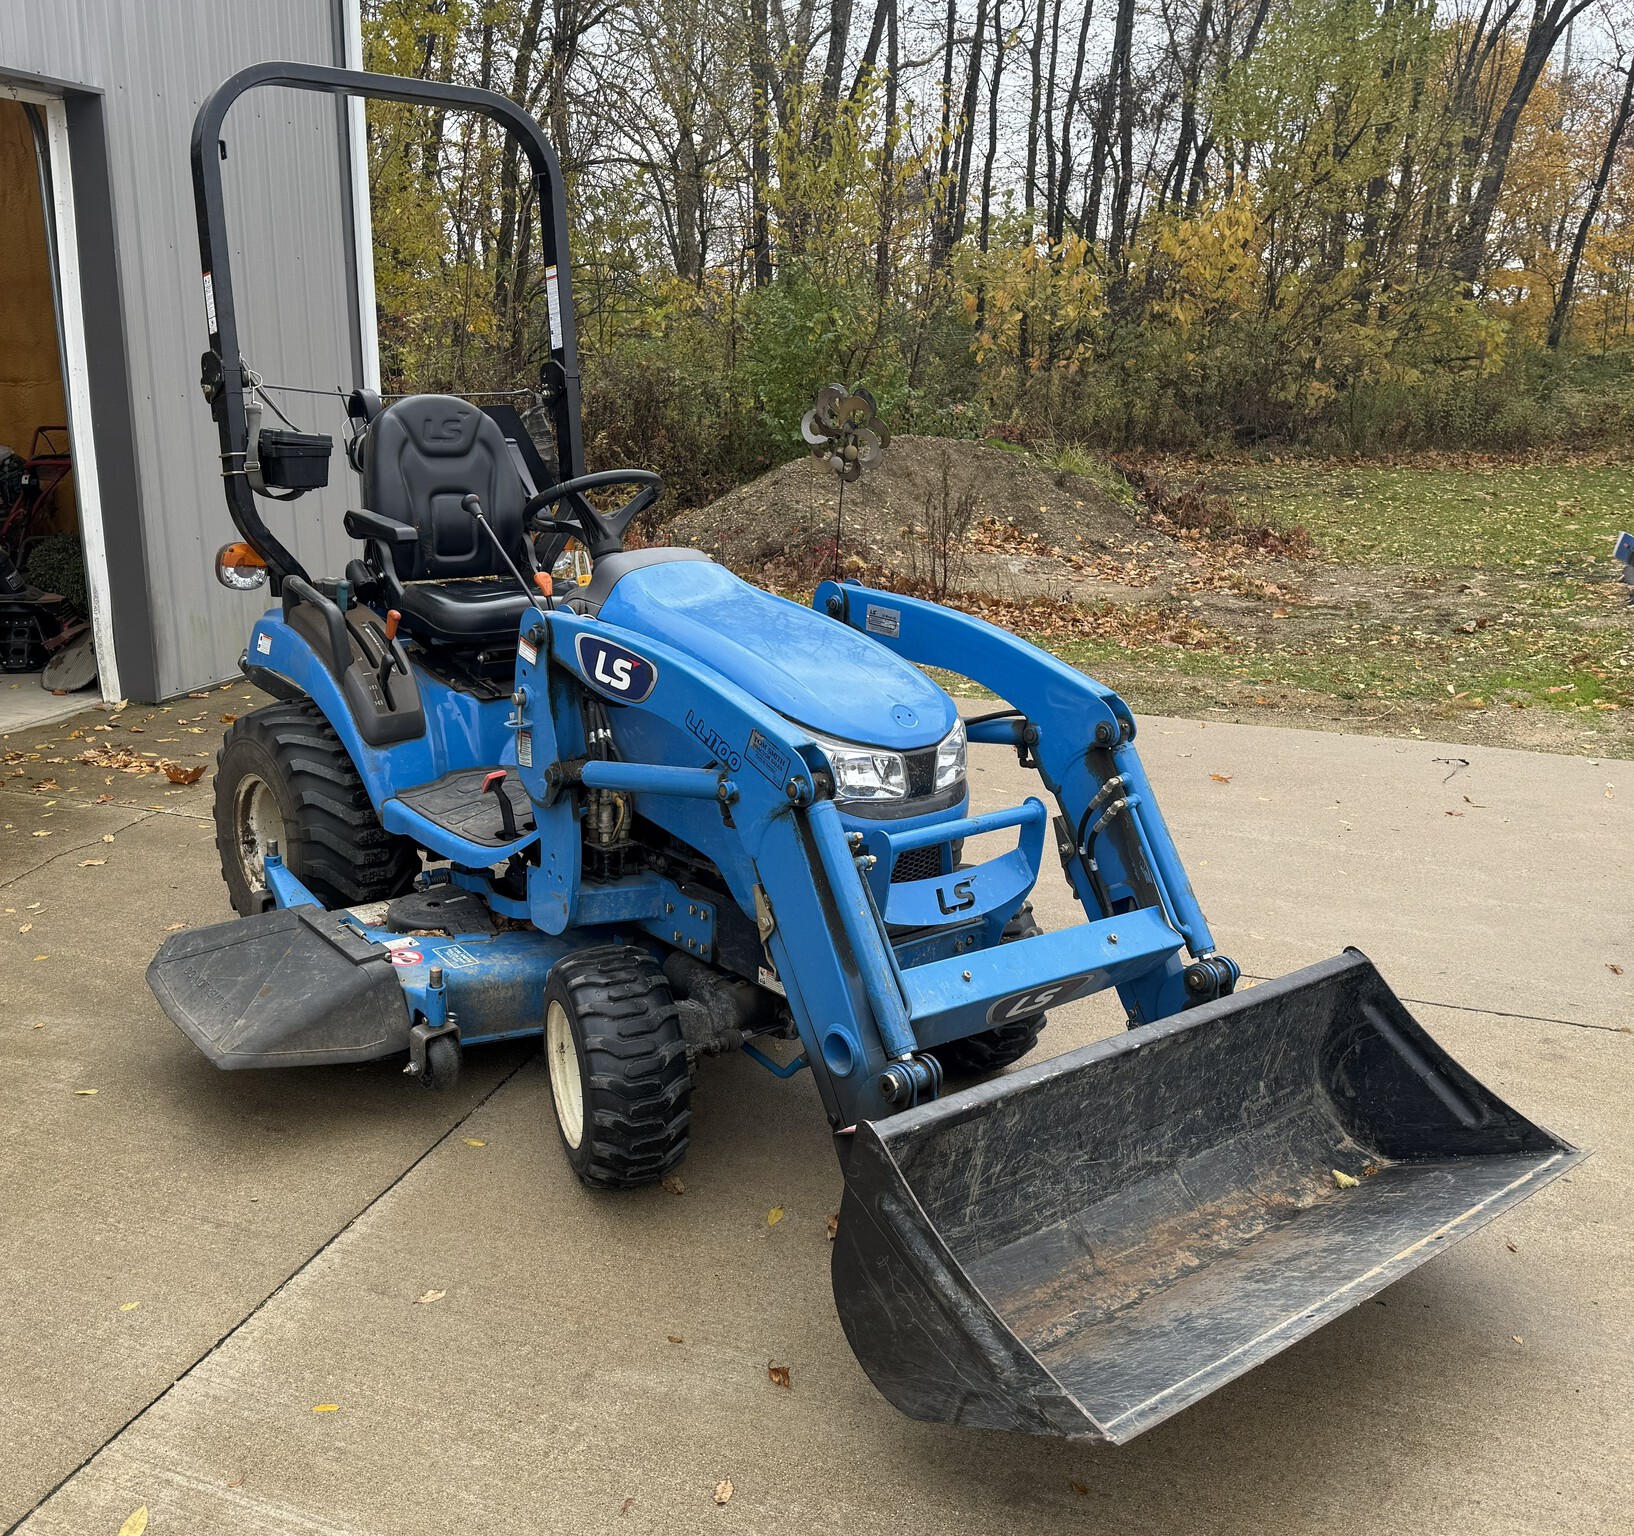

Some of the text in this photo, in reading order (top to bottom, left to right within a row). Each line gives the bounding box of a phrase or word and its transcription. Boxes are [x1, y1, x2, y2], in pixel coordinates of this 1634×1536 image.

[423, 418, 463, 445] LS
[595, 650, 633, 690] LS
[685, 708, 742, 772] LL1100
[753, 736, 786, 766] TOM SMITH
[936, 880, 976, 915] LS
[1005, 986, 1063, 1018] LS
